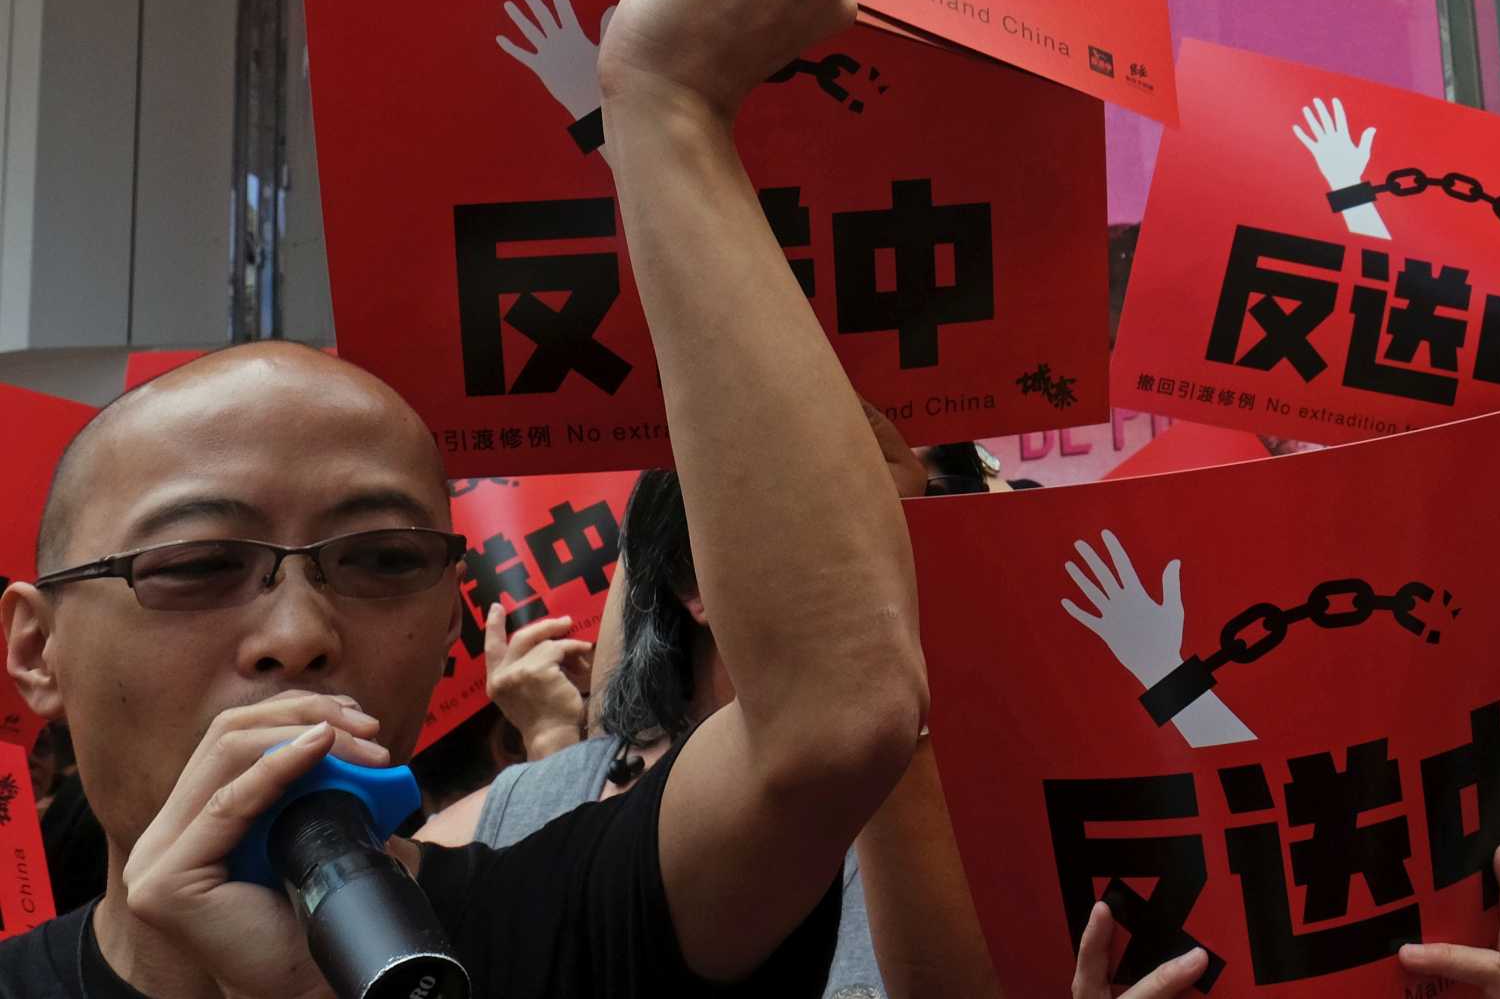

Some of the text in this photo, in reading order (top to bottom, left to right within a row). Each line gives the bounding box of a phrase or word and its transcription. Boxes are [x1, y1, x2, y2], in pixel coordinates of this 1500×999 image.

[1002, 15, 1072, 58] China
[924, 391, 997, 416] China
[1136, 372, 1397, 435] 撤回引渡修例 No extradition
[433, 423, 552, 453] 引渡修例
[567, 424, 601, 445] No
[14, 848, 36, 914] China
